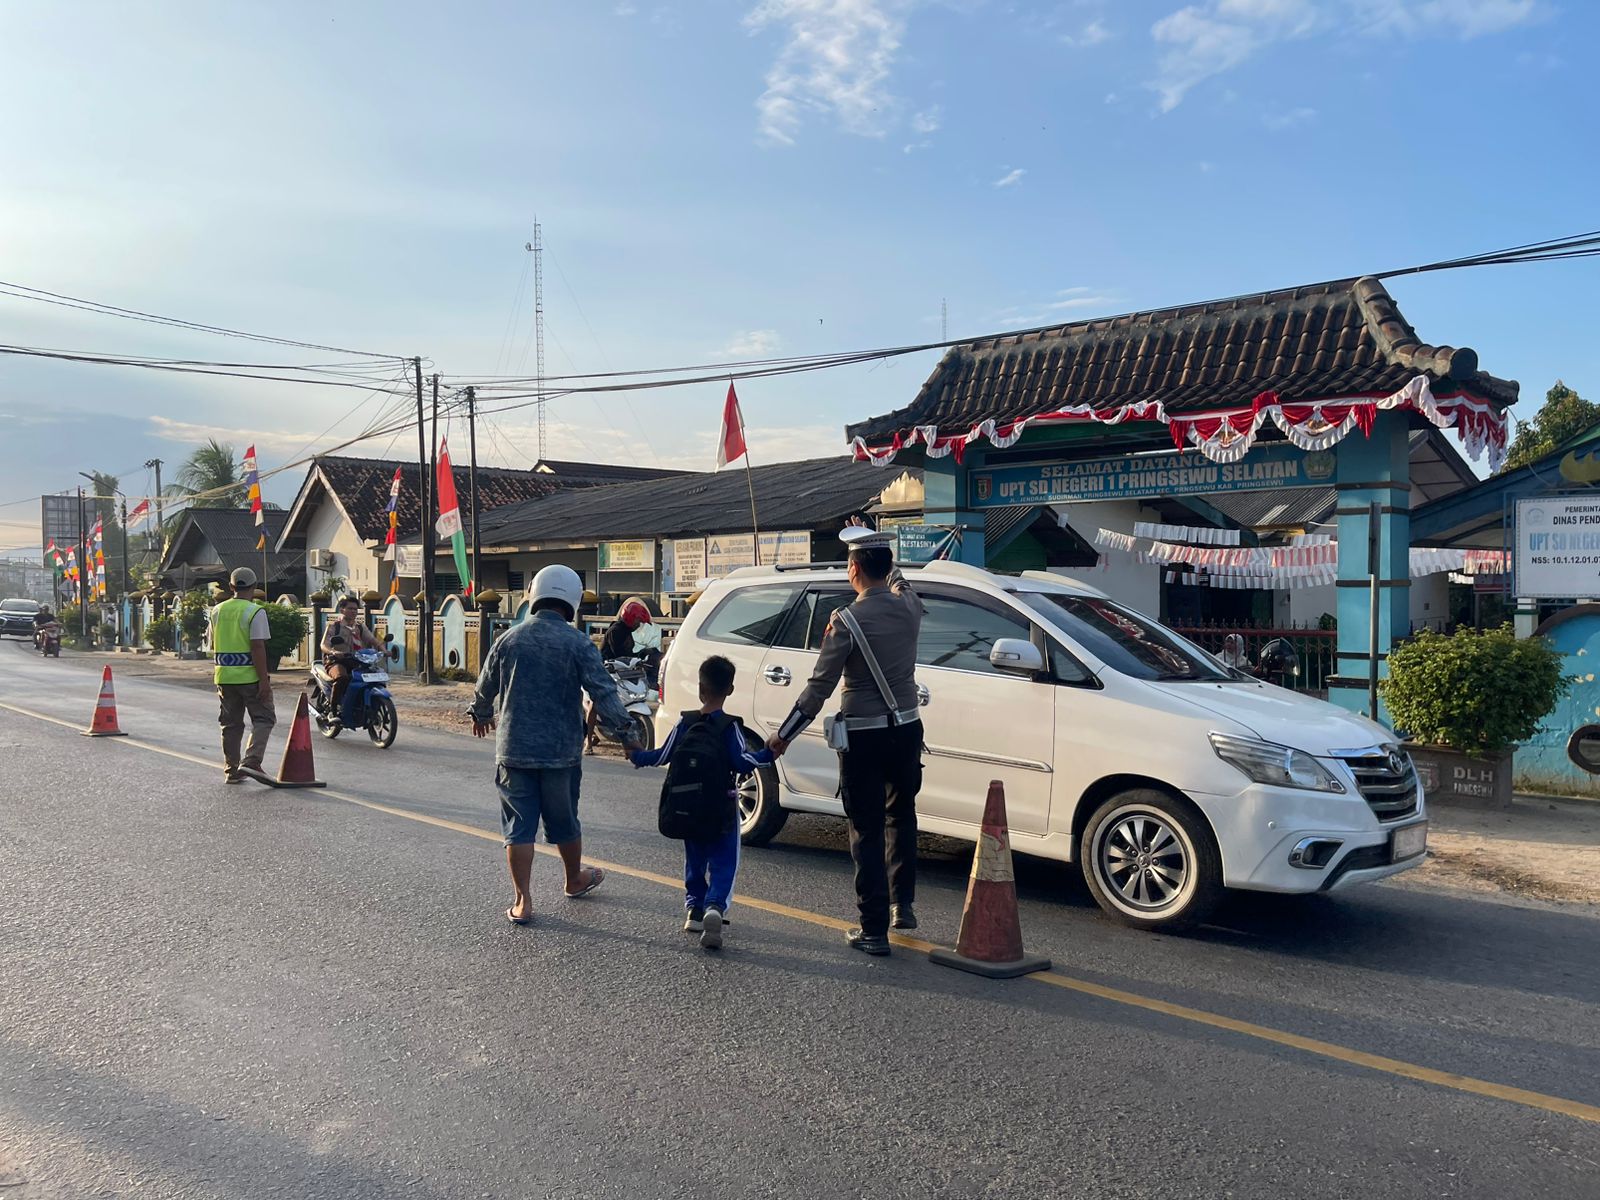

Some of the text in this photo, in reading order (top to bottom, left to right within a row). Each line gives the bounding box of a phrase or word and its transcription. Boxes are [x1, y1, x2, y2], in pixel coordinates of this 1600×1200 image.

[1041, 454, 1210, 478] SELAMAT DATANG
[1000, 460, 1298, 497] UPT SD NEGERI 1 PRINGSEWU SELATAN
[1020, 495, 1047, 503] JENDRAL
[1048, 493, 1082, 501] SUDIRMAN
[1083, 490, 1123, 498] PRINGSEWU
[1126, 487, 1155, 496] SELATAN
[1237, 479, 1284, 489] PRINGSEWU
[1553, 516, 1577, 525] DINAS
[1529, 532, 1550, 551] UPT
[1552, 532, 1567, 550] SD
[1531, 556, 1550, 564] NSS:
